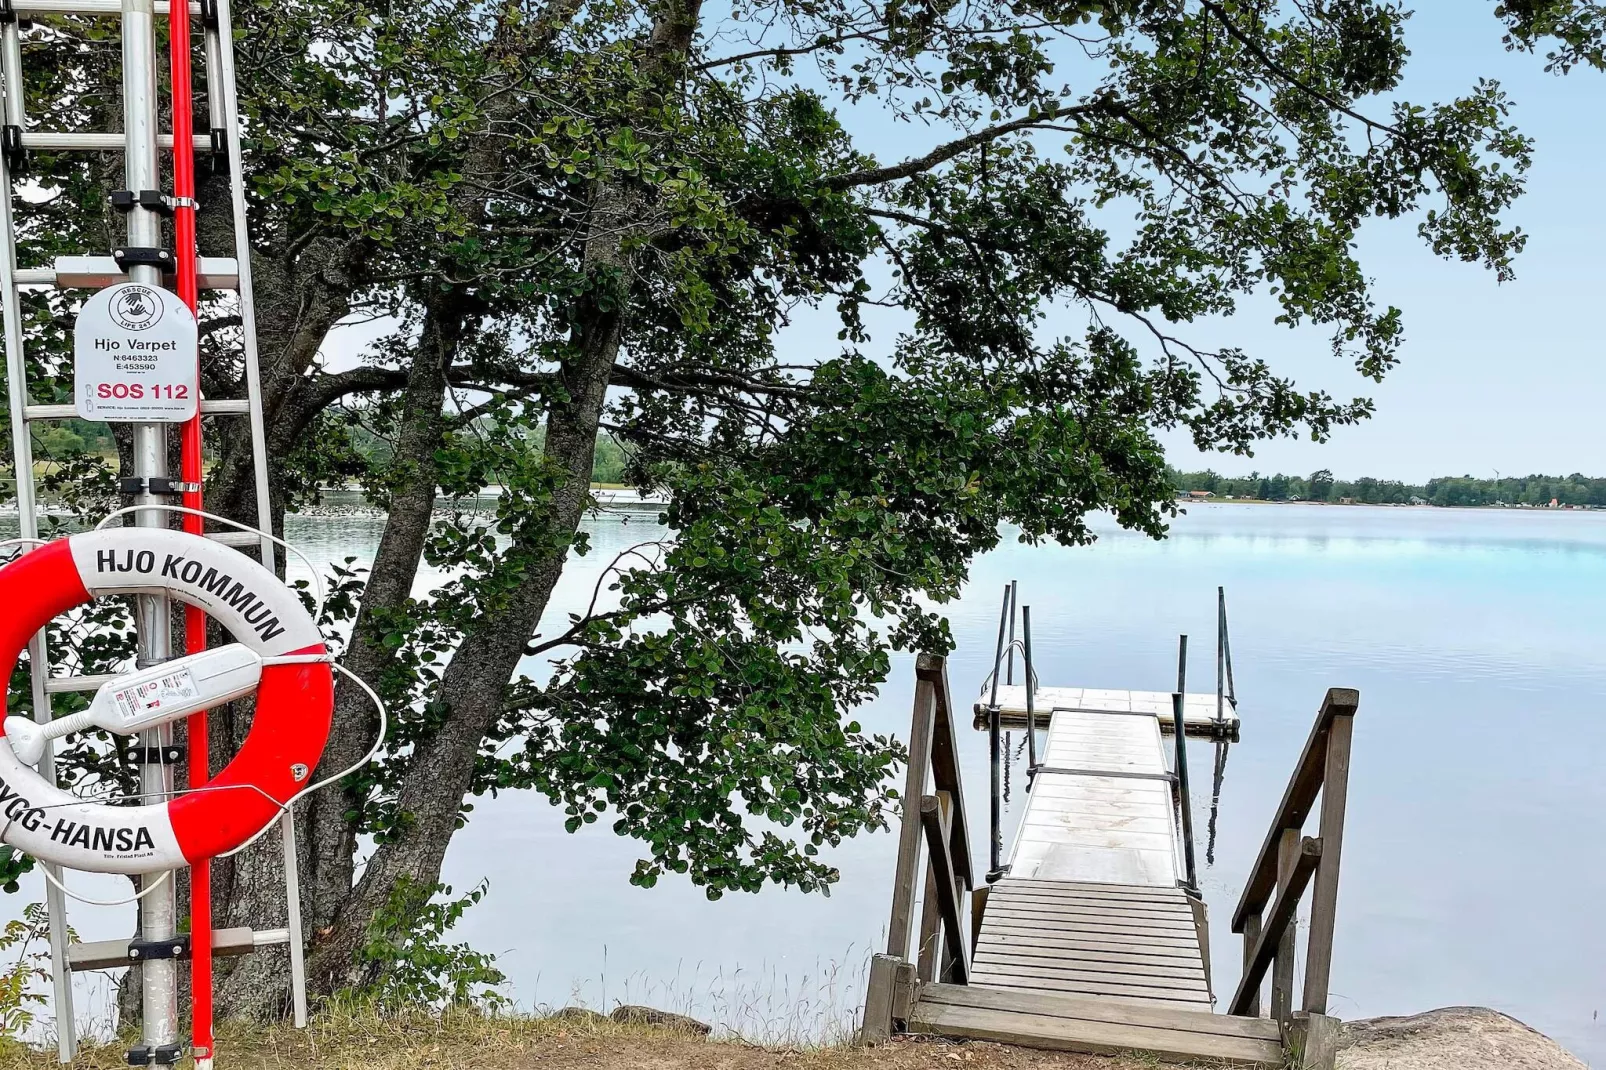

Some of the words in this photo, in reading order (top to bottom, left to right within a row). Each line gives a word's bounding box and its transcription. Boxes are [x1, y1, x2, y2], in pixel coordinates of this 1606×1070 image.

[122, 287, 152, 296] RESCUE
[121, 320, 136, 329] LIFE
[138, 321, 151, 329] 247
[94, 338, 120, 352] Hjo
[127, 338, 177, 352] Varpet
[97, 383, 144, 399] SOS
[151, 384, 188, 399] 112
[97, 549, 155, 573] HJO
[161, 554, 286, 642] KOMMUN
